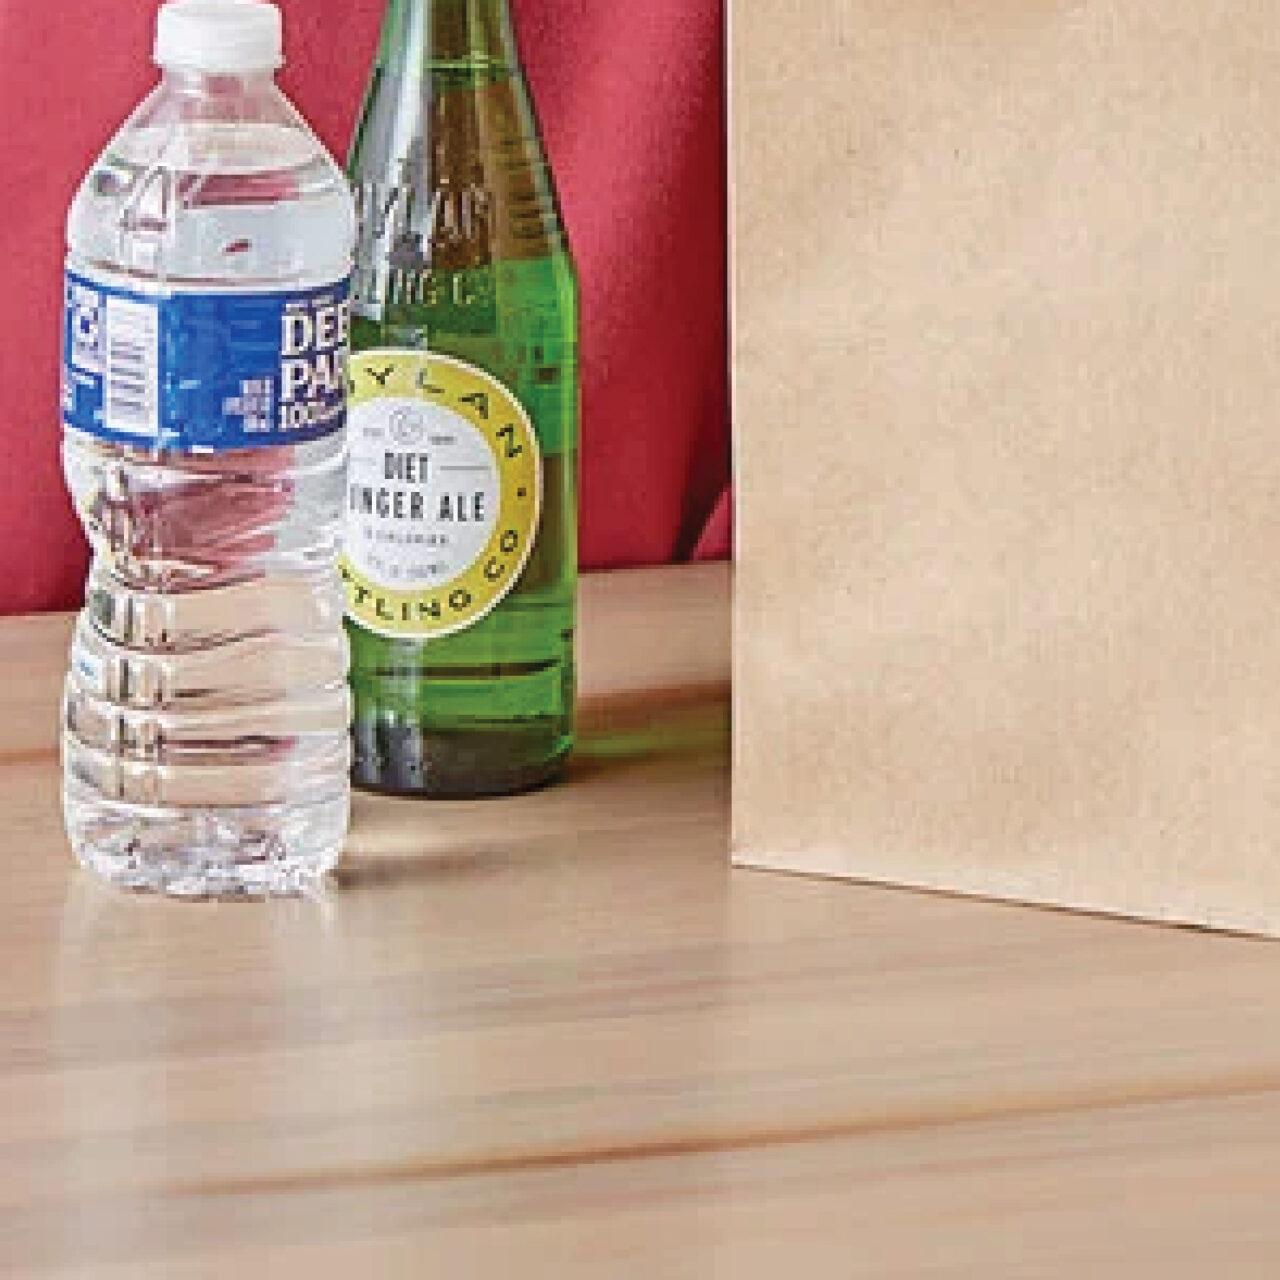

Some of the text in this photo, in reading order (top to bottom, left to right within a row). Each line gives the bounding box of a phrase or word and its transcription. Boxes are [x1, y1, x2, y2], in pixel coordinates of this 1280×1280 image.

[349, 366, 523, 458] YLAN
[384, 451, 428, 483] DIET
[349, 486, 485, 522] INGER ALE
